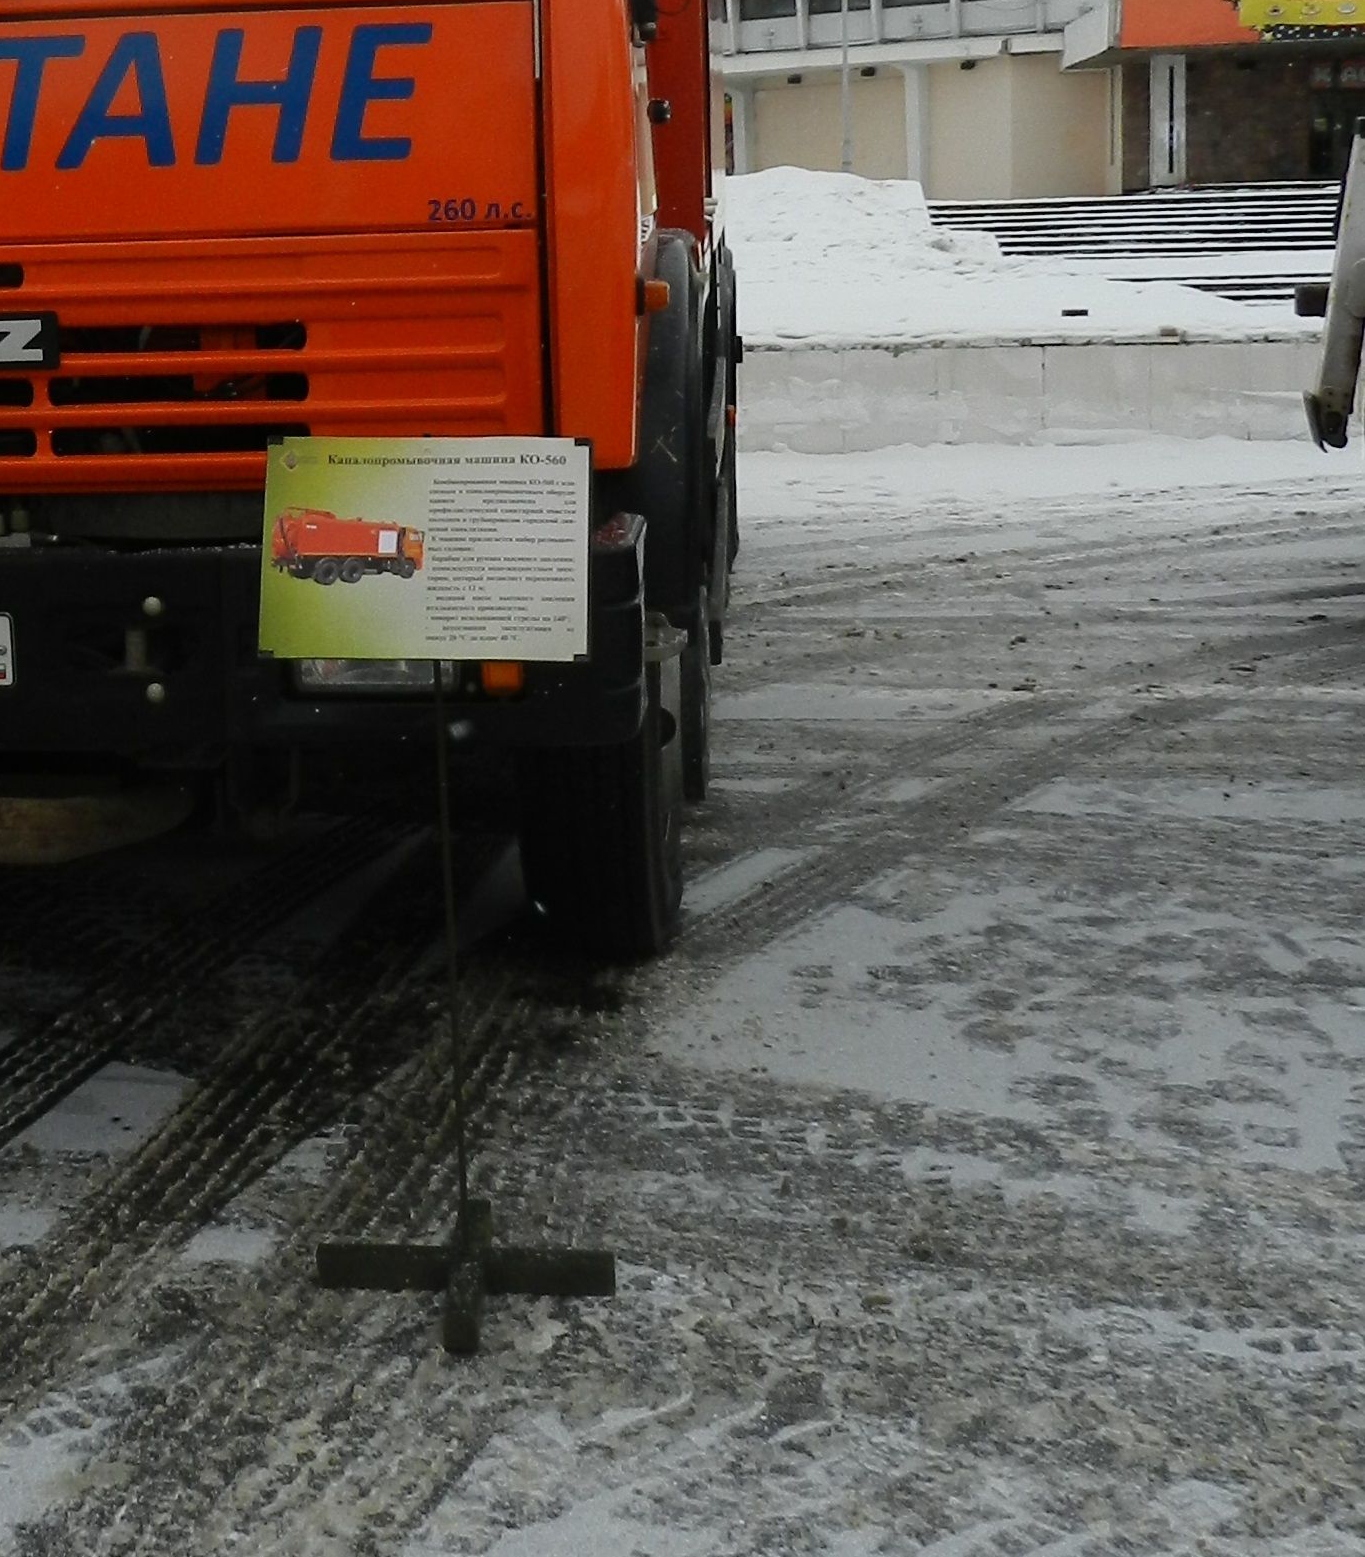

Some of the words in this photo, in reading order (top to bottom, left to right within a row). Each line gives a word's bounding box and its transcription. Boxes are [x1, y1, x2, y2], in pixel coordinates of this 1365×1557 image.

[428, 198, 476, 222] 260
[485, 202, 532, 220] л.с.
[328, 454, 461, 467] Каналопромывочная
[465, 455, 516, 466] машина
[520, 454, 567, 466] КО-560
